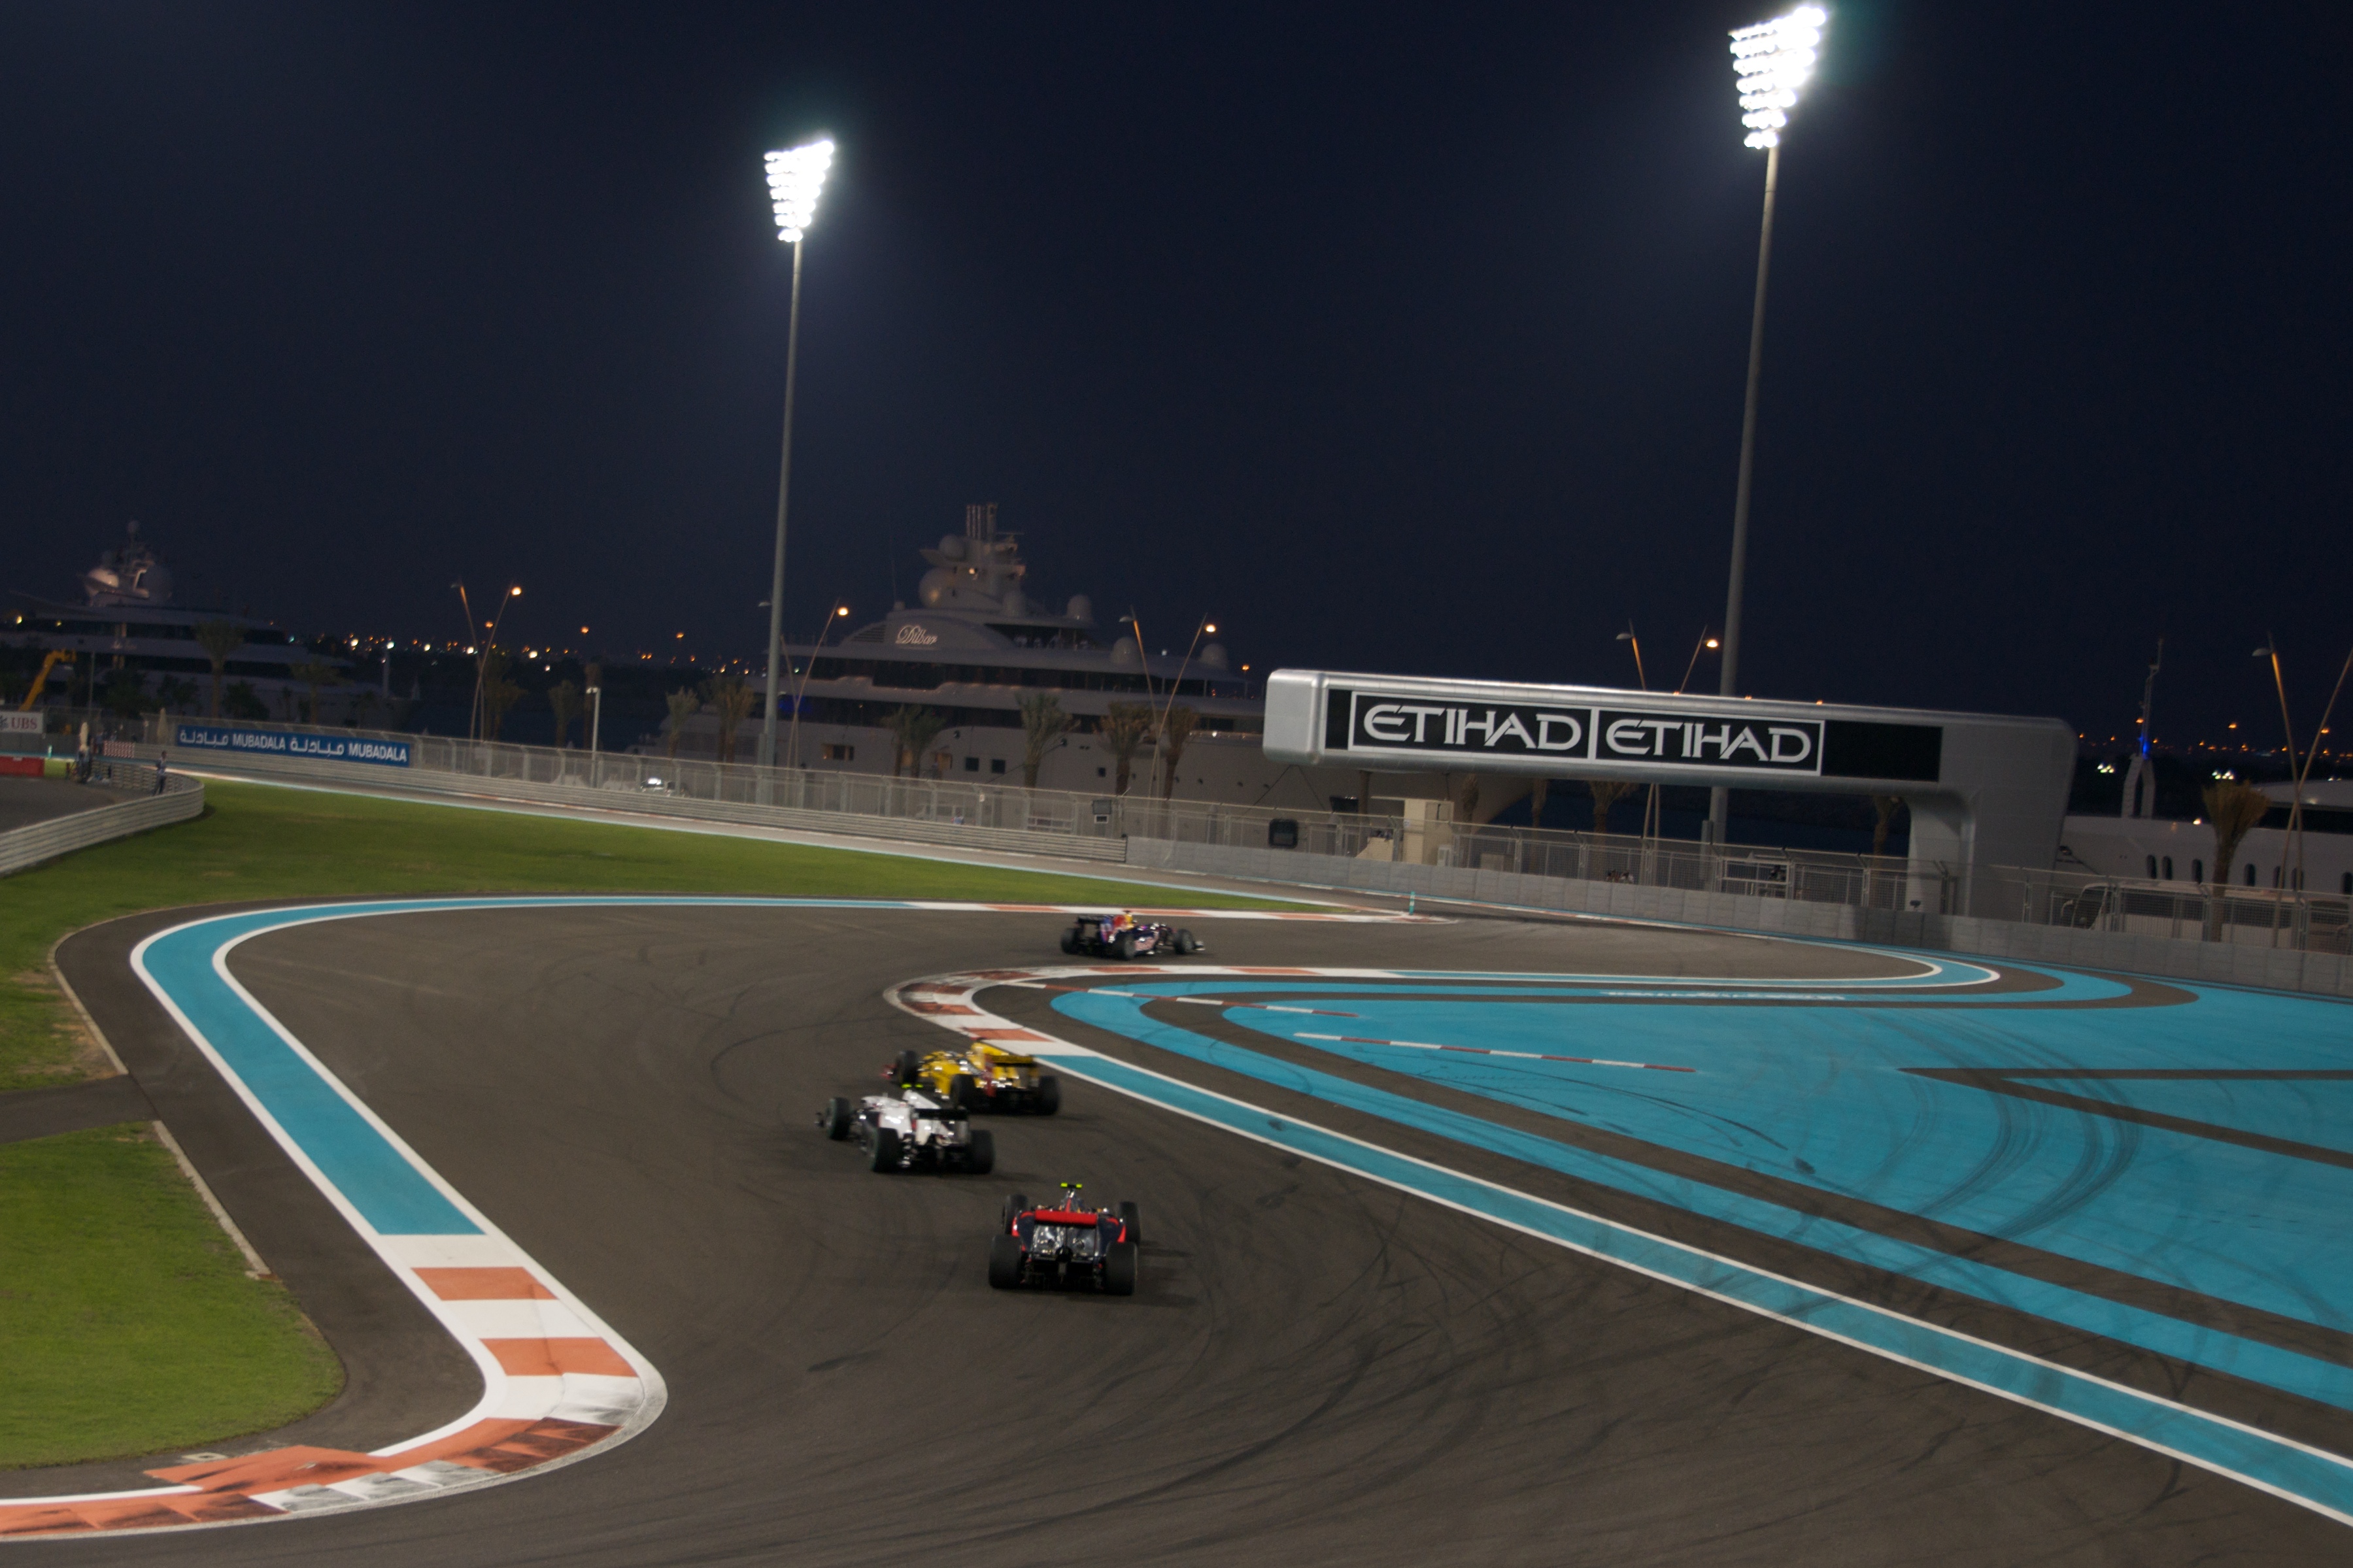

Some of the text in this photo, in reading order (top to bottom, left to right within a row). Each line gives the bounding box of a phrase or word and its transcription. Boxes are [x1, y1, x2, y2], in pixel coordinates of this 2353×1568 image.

[895, 624, 938, 645] Dilbar
[11, 717, 37, 730] UBS
[1363, 703, 1811, 763] ETIHAD ETIHAD
[232, 733, 286, 752] MUBADALA
[348, 742, 407, 762] MUBADALA
